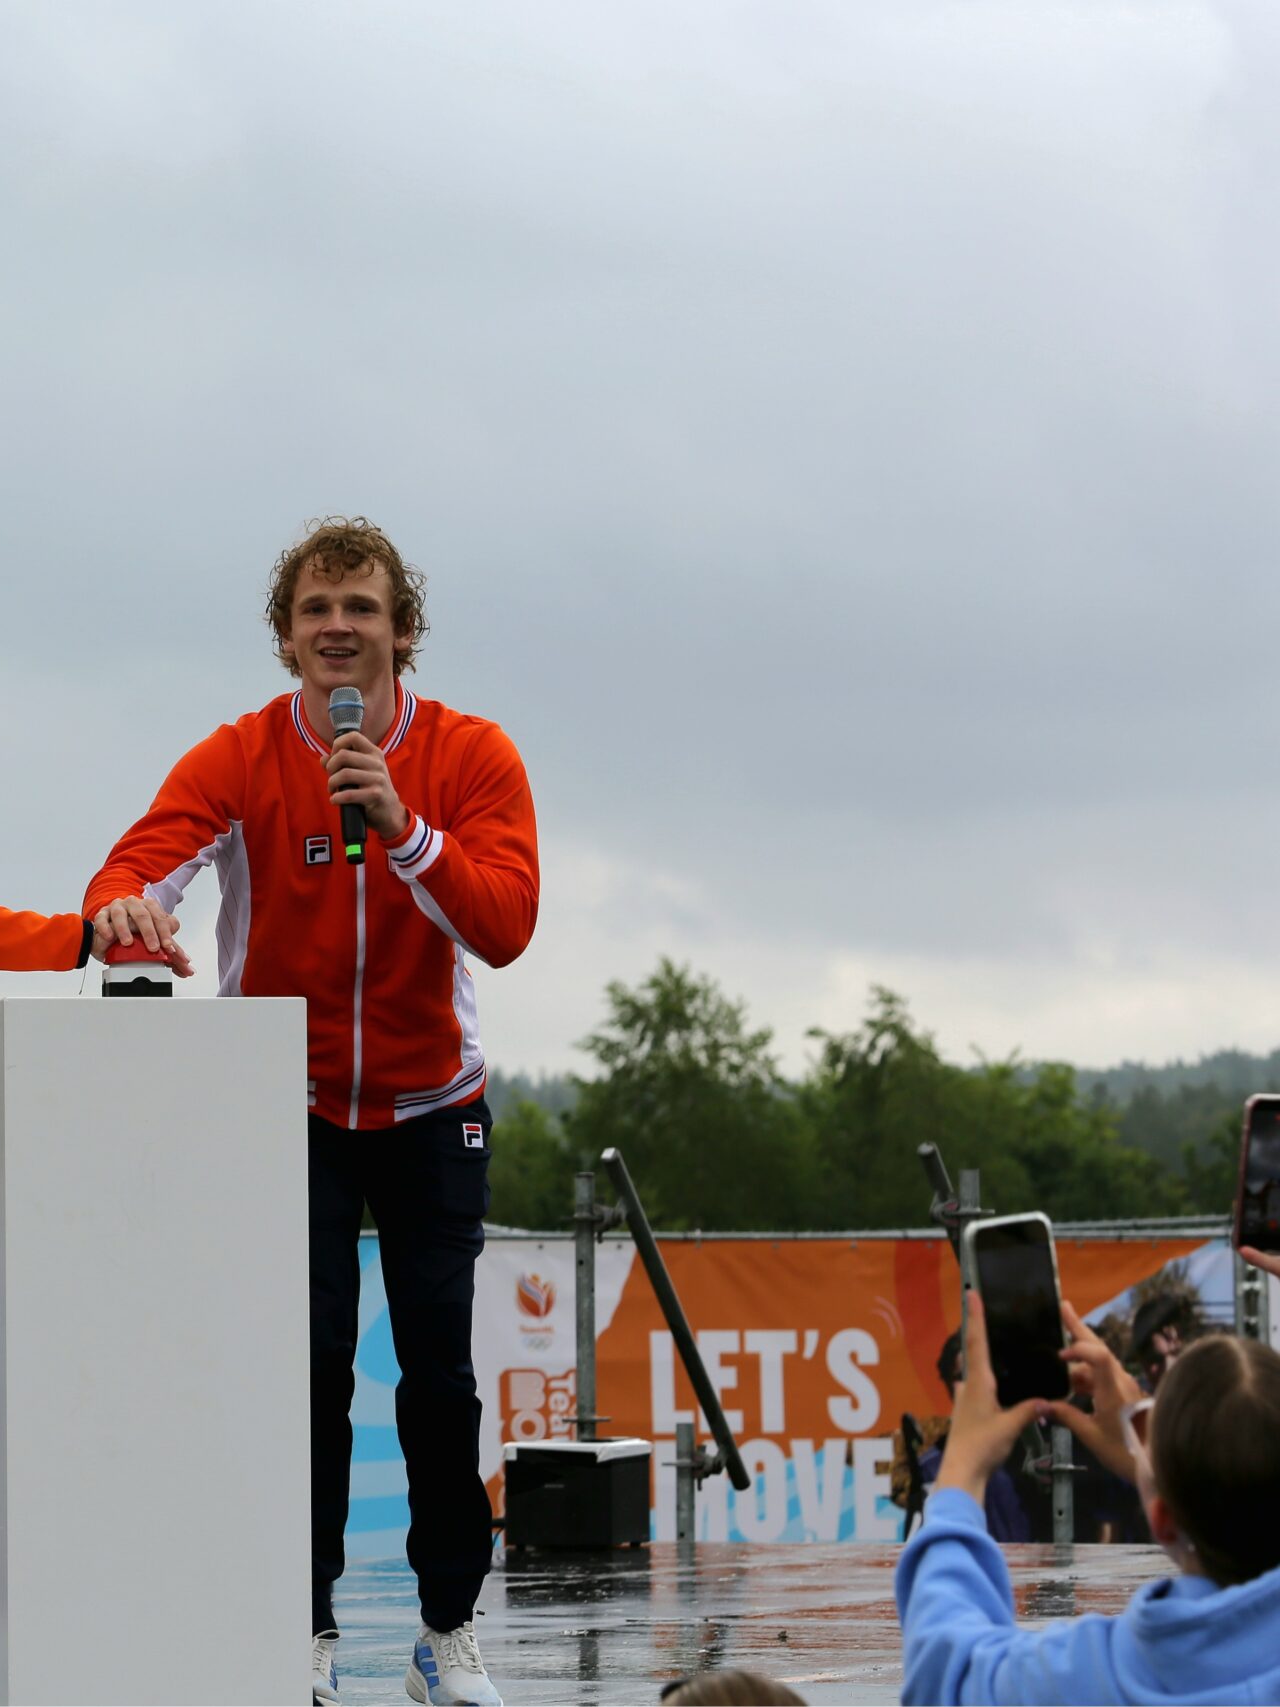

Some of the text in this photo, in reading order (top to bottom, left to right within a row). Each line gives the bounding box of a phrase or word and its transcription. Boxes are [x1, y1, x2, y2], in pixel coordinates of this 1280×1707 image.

[549, 1372, 577, 1442] Tea
[649, 1327, 881, 1435] LET'S
[653, 1437, 898, 1542] MOVE
